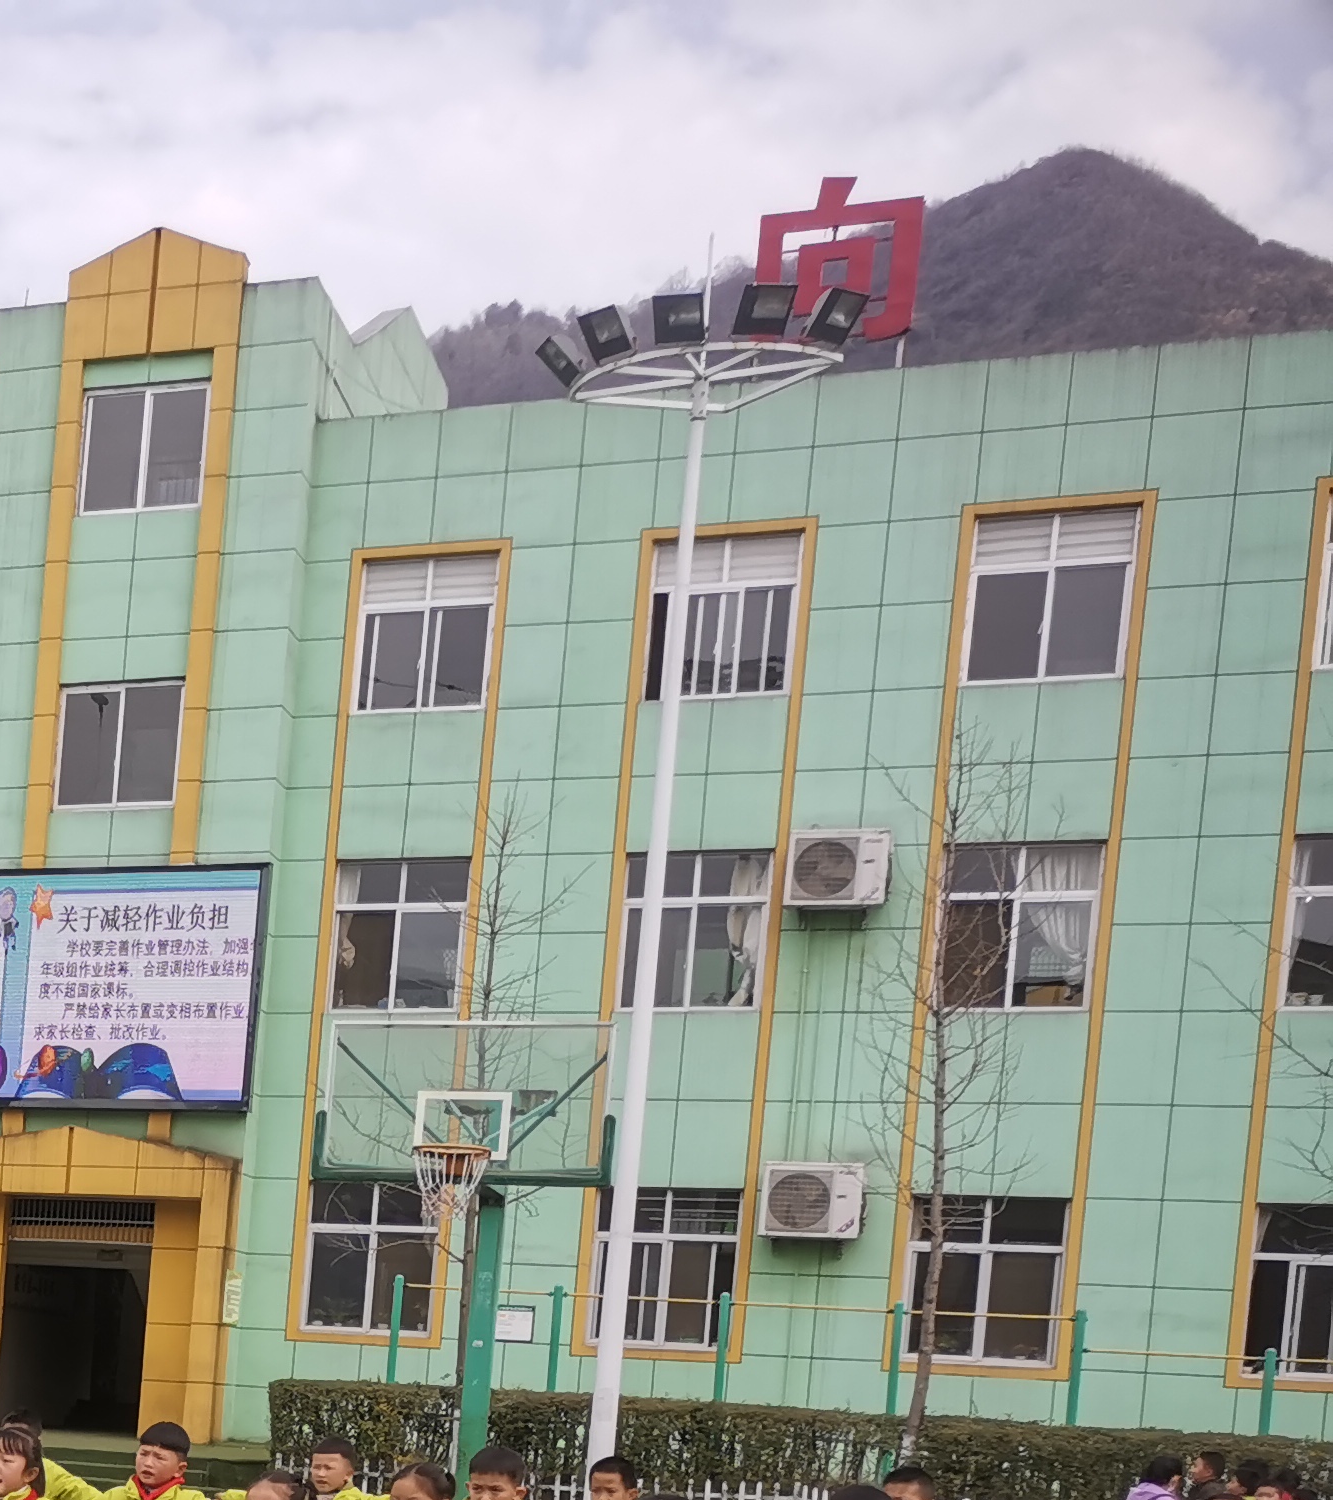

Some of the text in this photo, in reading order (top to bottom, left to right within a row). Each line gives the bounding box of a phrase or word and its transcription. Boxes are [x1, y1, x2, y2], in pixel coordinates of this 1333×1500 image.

[755, 177, 924, 342] 向
[56, 902, 230, 935] 关于减轻作业负担
